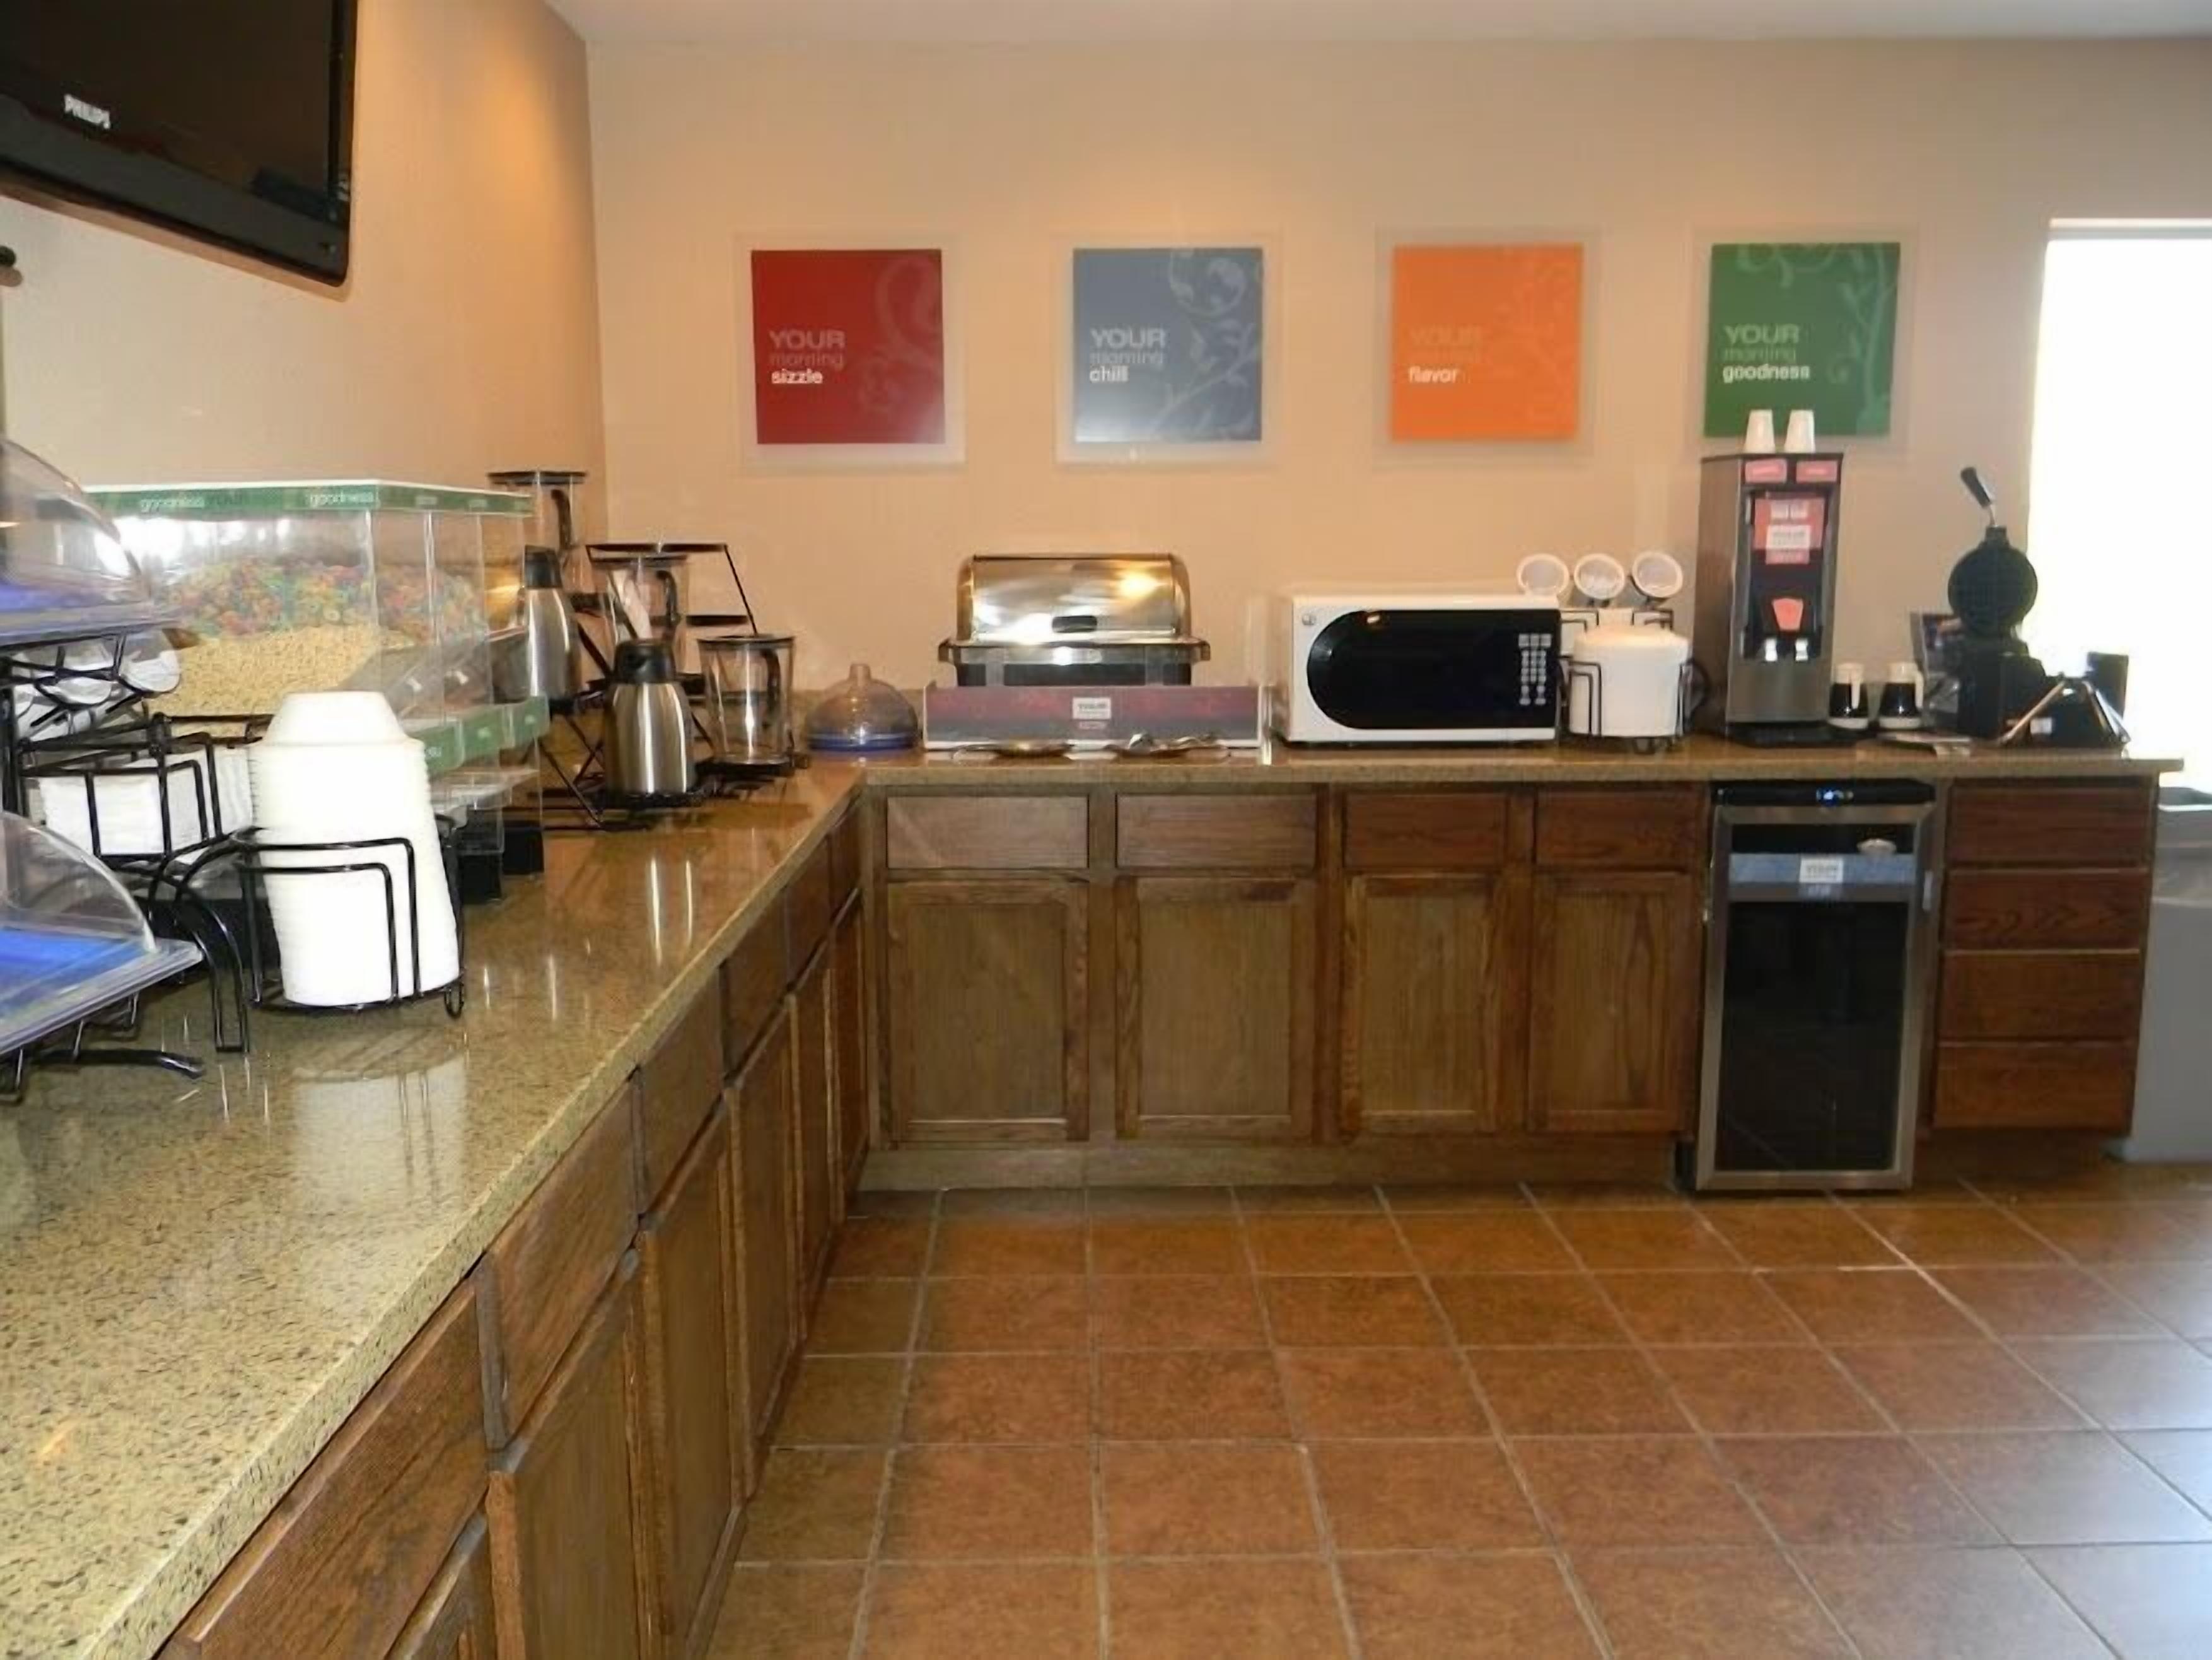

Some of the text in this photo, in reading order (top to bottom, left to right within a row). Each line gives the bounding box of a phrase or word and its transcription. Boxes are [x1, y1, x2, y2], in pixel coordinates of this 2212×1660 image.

[769, 329, 846, 349] YOUR
[1091, 327, 1165, 348] YOUR
[1724, 323, 1800, 344] YOUR
[769, 352, 844, 371] morning
[771, 368, 823, 384] sizzle
[1090, 365, 1129, 382] chill
[1408, 366, 1458, 383] flavor
[1723, 364, 1810, 383] goodness
